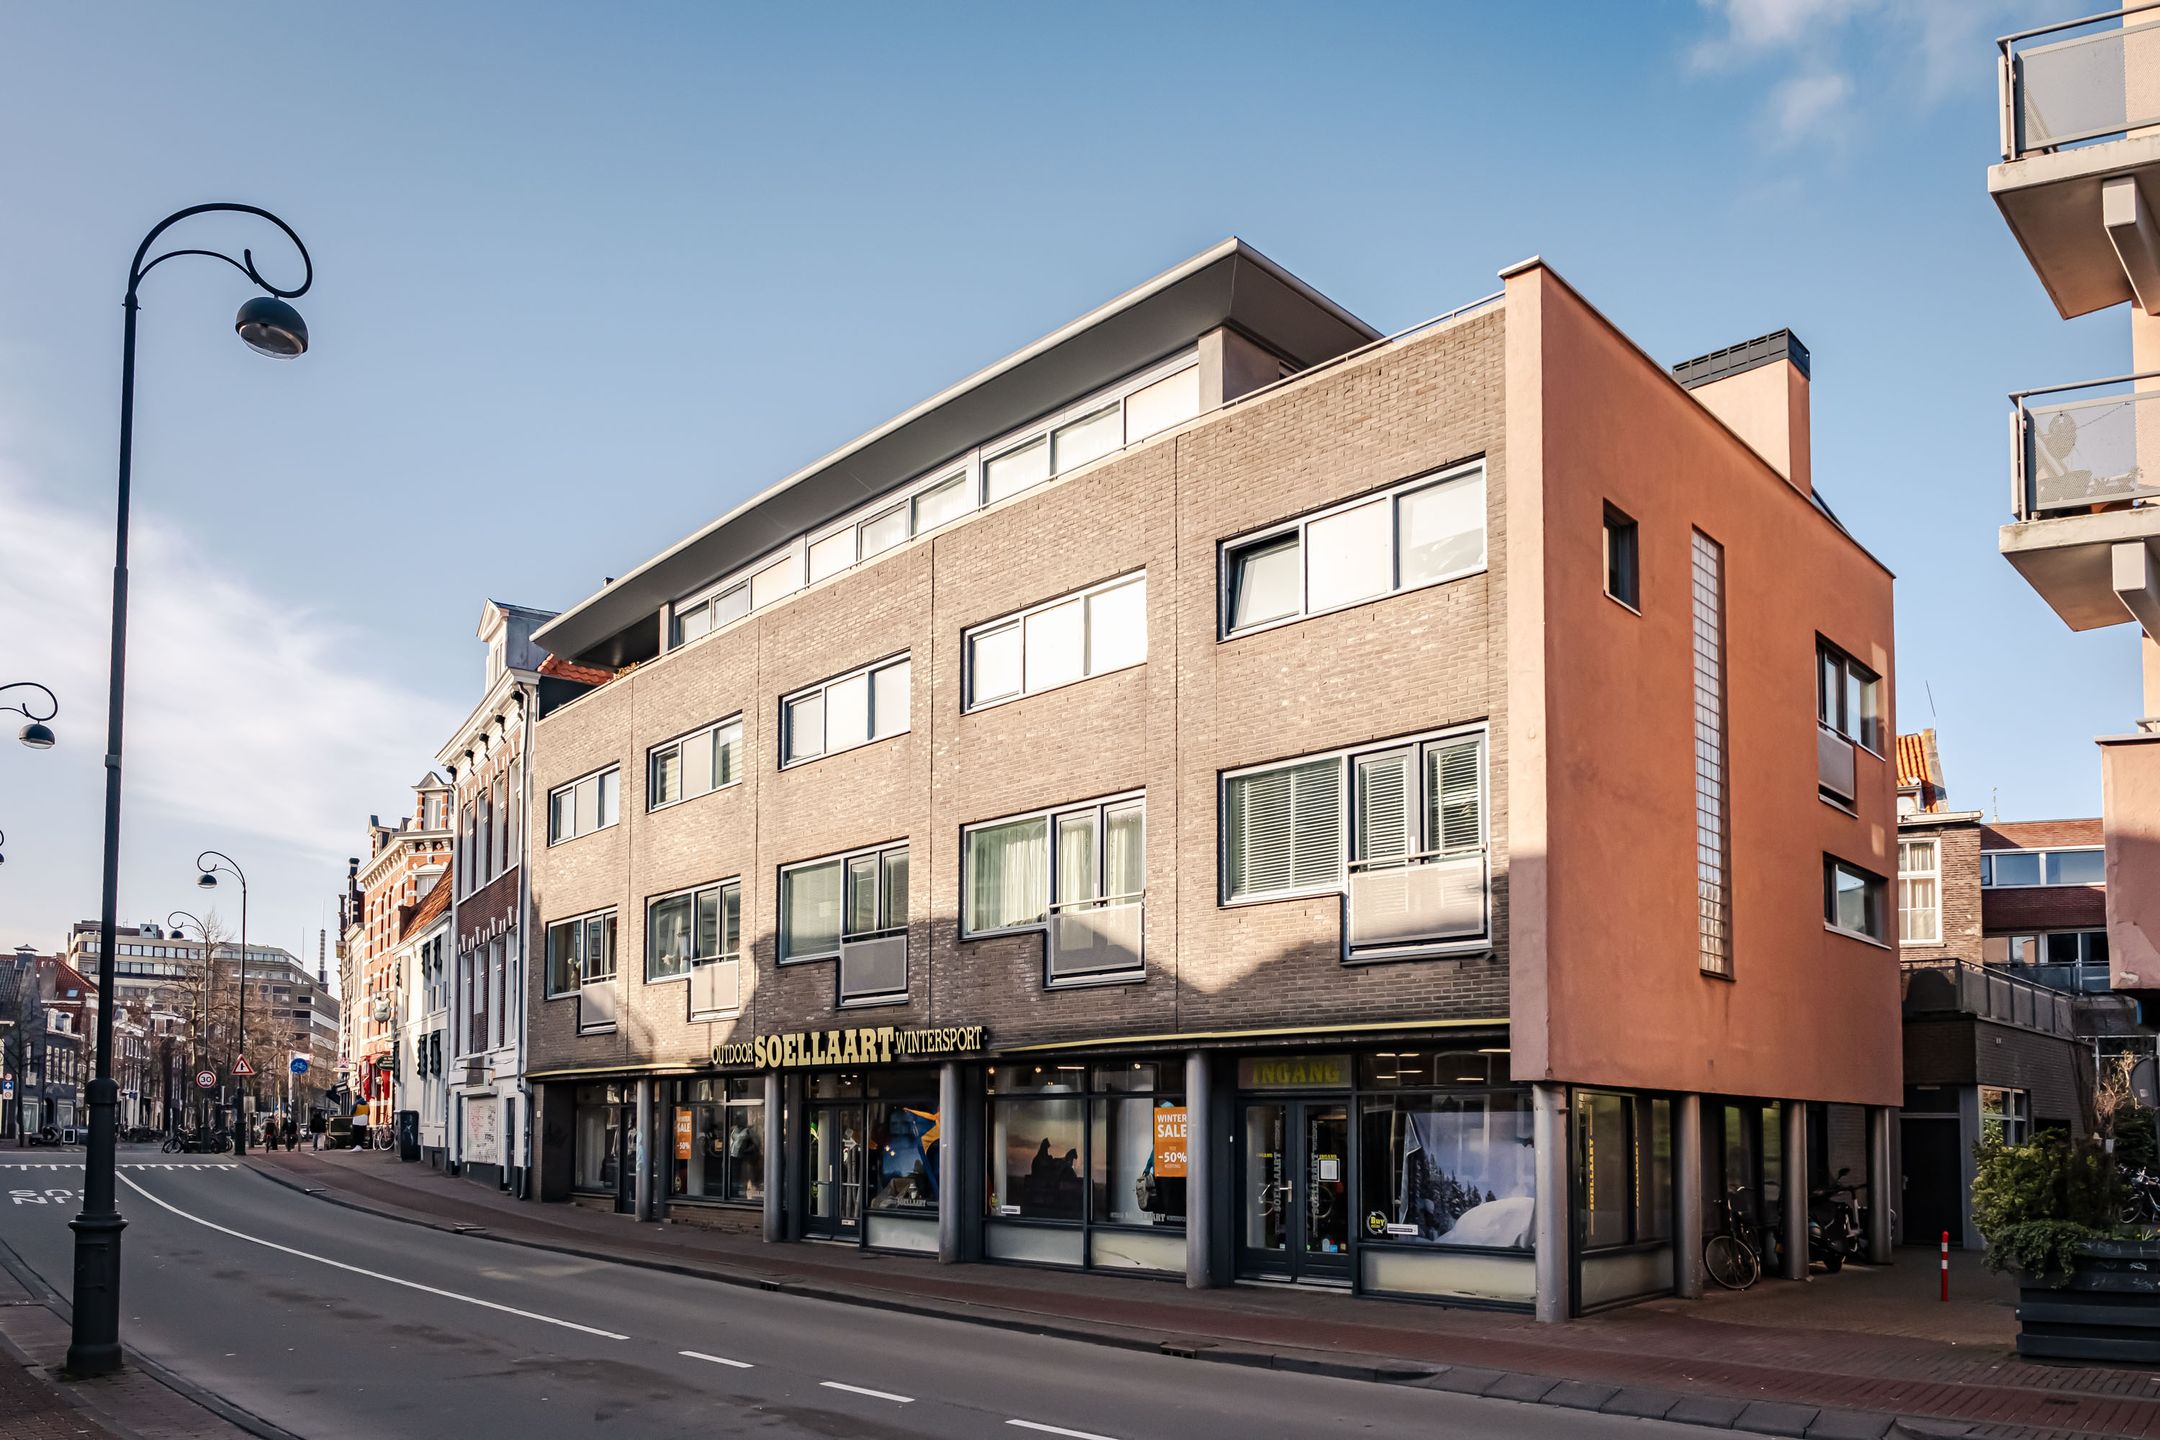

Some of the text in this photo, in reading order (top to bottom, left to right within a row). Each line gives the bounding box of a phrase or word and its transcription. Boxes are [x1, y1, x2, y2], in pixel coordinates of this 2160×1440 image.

[712, 1026, 983, 1068] OUTDOOR SOELLAART WINTERSPORT
[1252, 1062, 1341, 1085] INGANG
[1157, 1113, 1187, 1123] WINTER
[677, 1122, 690, 1133] SALE
[1157, 1124, 1187, 1138] SALE
[1158, 1152, 1187, 1164] -50%
[1370, 1216, 1385, 1226] Buy
